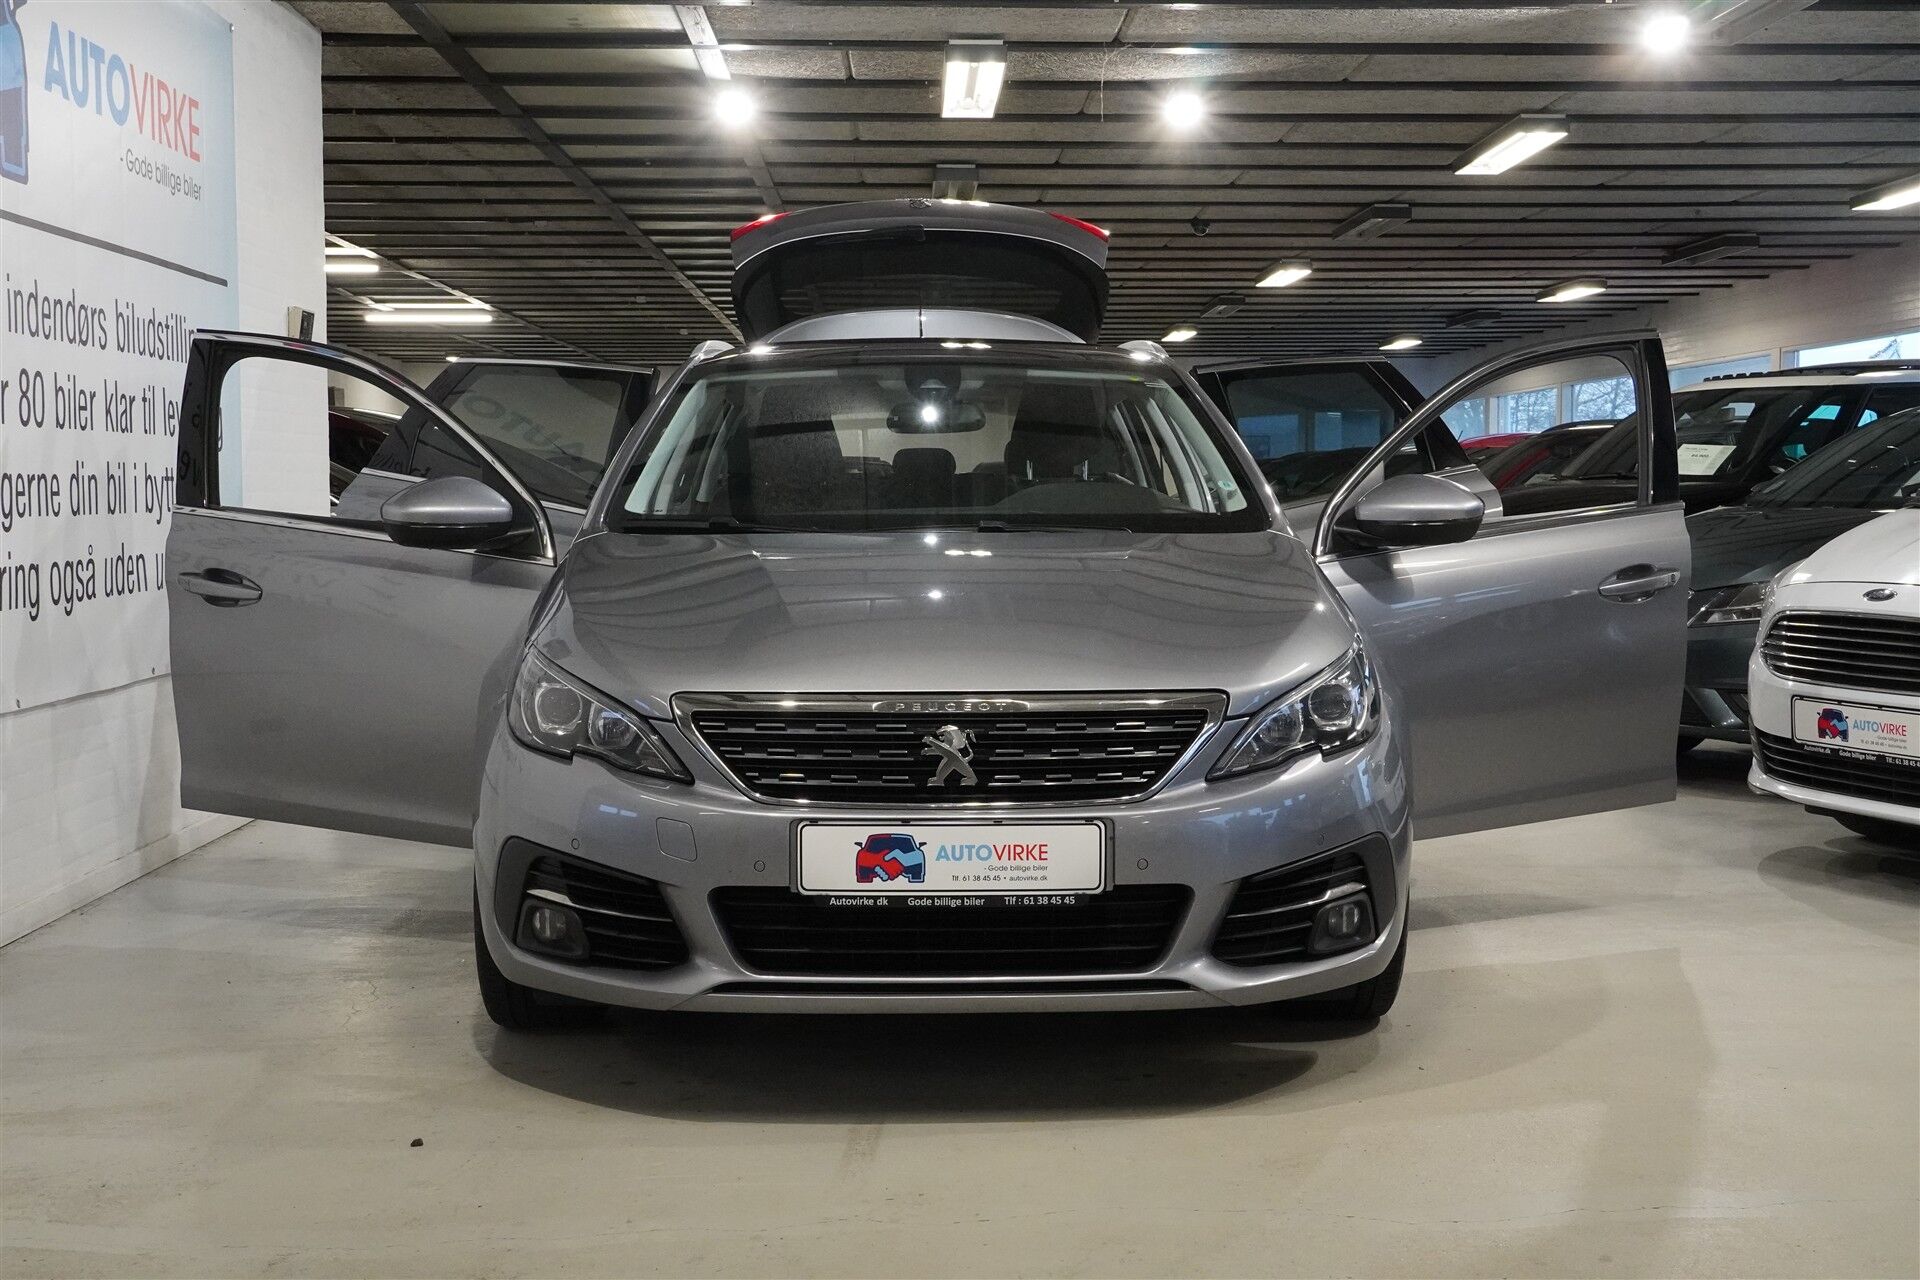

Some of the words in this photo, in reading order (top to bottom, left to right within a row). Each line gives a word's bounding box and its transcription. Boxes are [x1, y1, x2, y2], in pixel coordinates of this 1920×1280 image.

[44, 21, 200, 162] AUTOVIRKE
[126, 148, 153, 180] Gode
[155, 161, 181, 196] billige
[184, 173, 201, 201] biler
[6, 273, 107, 351] indendørs
[19, 368, 45, 428] 80
[54, 372, 97, 431] biler
[104, 379, 136, 433] klar
[142, 385, 156, 435] til
[1, 471, 60, 532] gerne
[69, 460, 99, 517] din
[107, 462, 127, 515] bil
[133, 462, 138, 514] i
[50, 544, 96, 616] også
[104, 542, 148, 597] uden
[895, 703, 1007, 711] PEUGEOT
[1853, 719, 1907, 736] AUTOVIRKE
[936, 844, 1048, 861] AUTOVIRKE
[1010, 865, 1031, 873] billige
[907, 897, 932, 906] Gode
[934, 897, 961, 907] billige
[964, 897, 985, 906] biler
[1023, 896, 1034, 905] 61
[1037, 896, 1048, 905] 38
[1050, 896, 1062, 905] 45
[1064, 896, 1075, 905] 45
